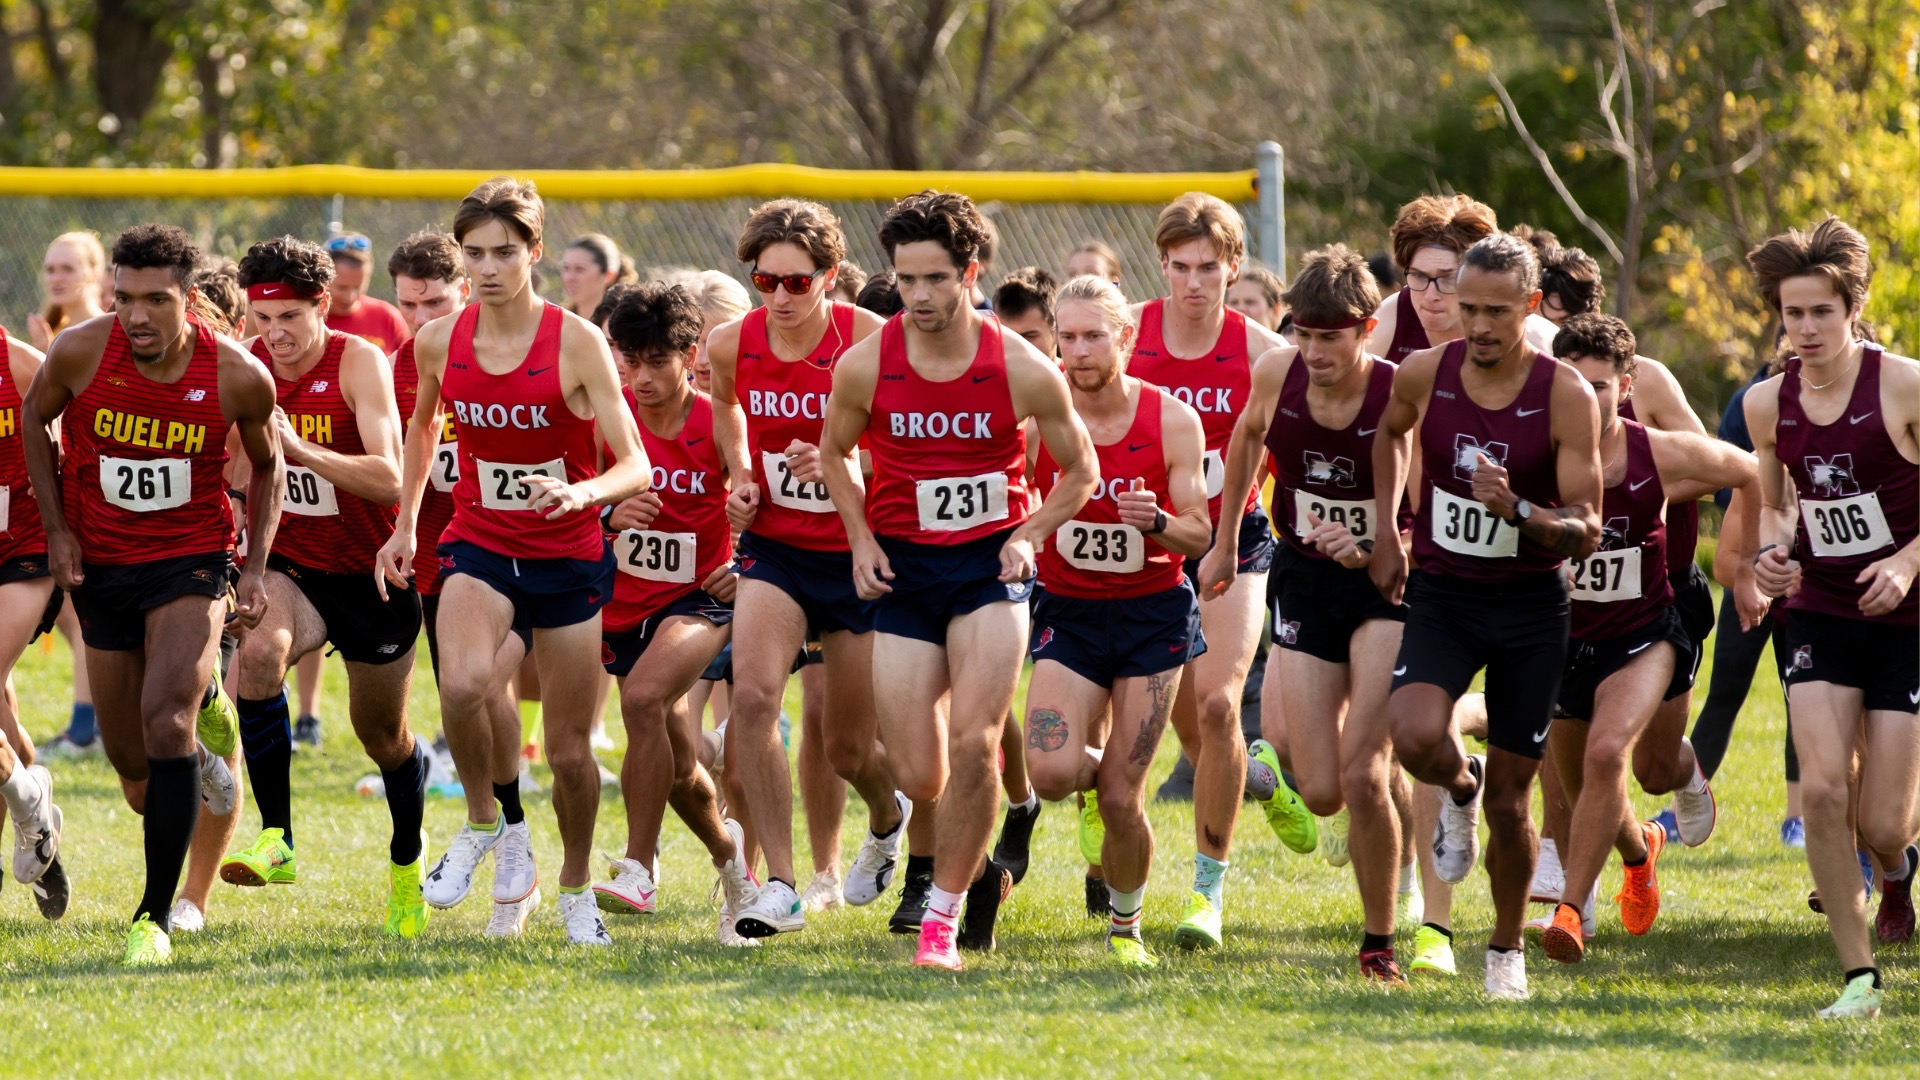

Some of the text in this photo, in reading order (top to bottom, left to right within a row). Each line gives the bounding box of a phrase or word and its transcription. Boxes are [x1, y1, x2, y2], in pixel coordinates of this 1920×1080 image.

[453, 400, 550, 430] BROCK
[1159, 385, 1232, 413] OCK
[94, 407, 207, 453] GUELPH
[890, 411, 993, 439] BROCK
[117, 464, 172, 501] 261
[283, 470, 320, 506] 60
[650, 465, 707, 494] OCK
[934, 479, 989, 521] 231
[1445, 501, 1503, 546] 307
[1814, 503, 1872, 546] 306
[628, 533, 681, 572] 230
[1072, 527, 1128, 563] 233
[1570, 556, 1625, 592] 297
